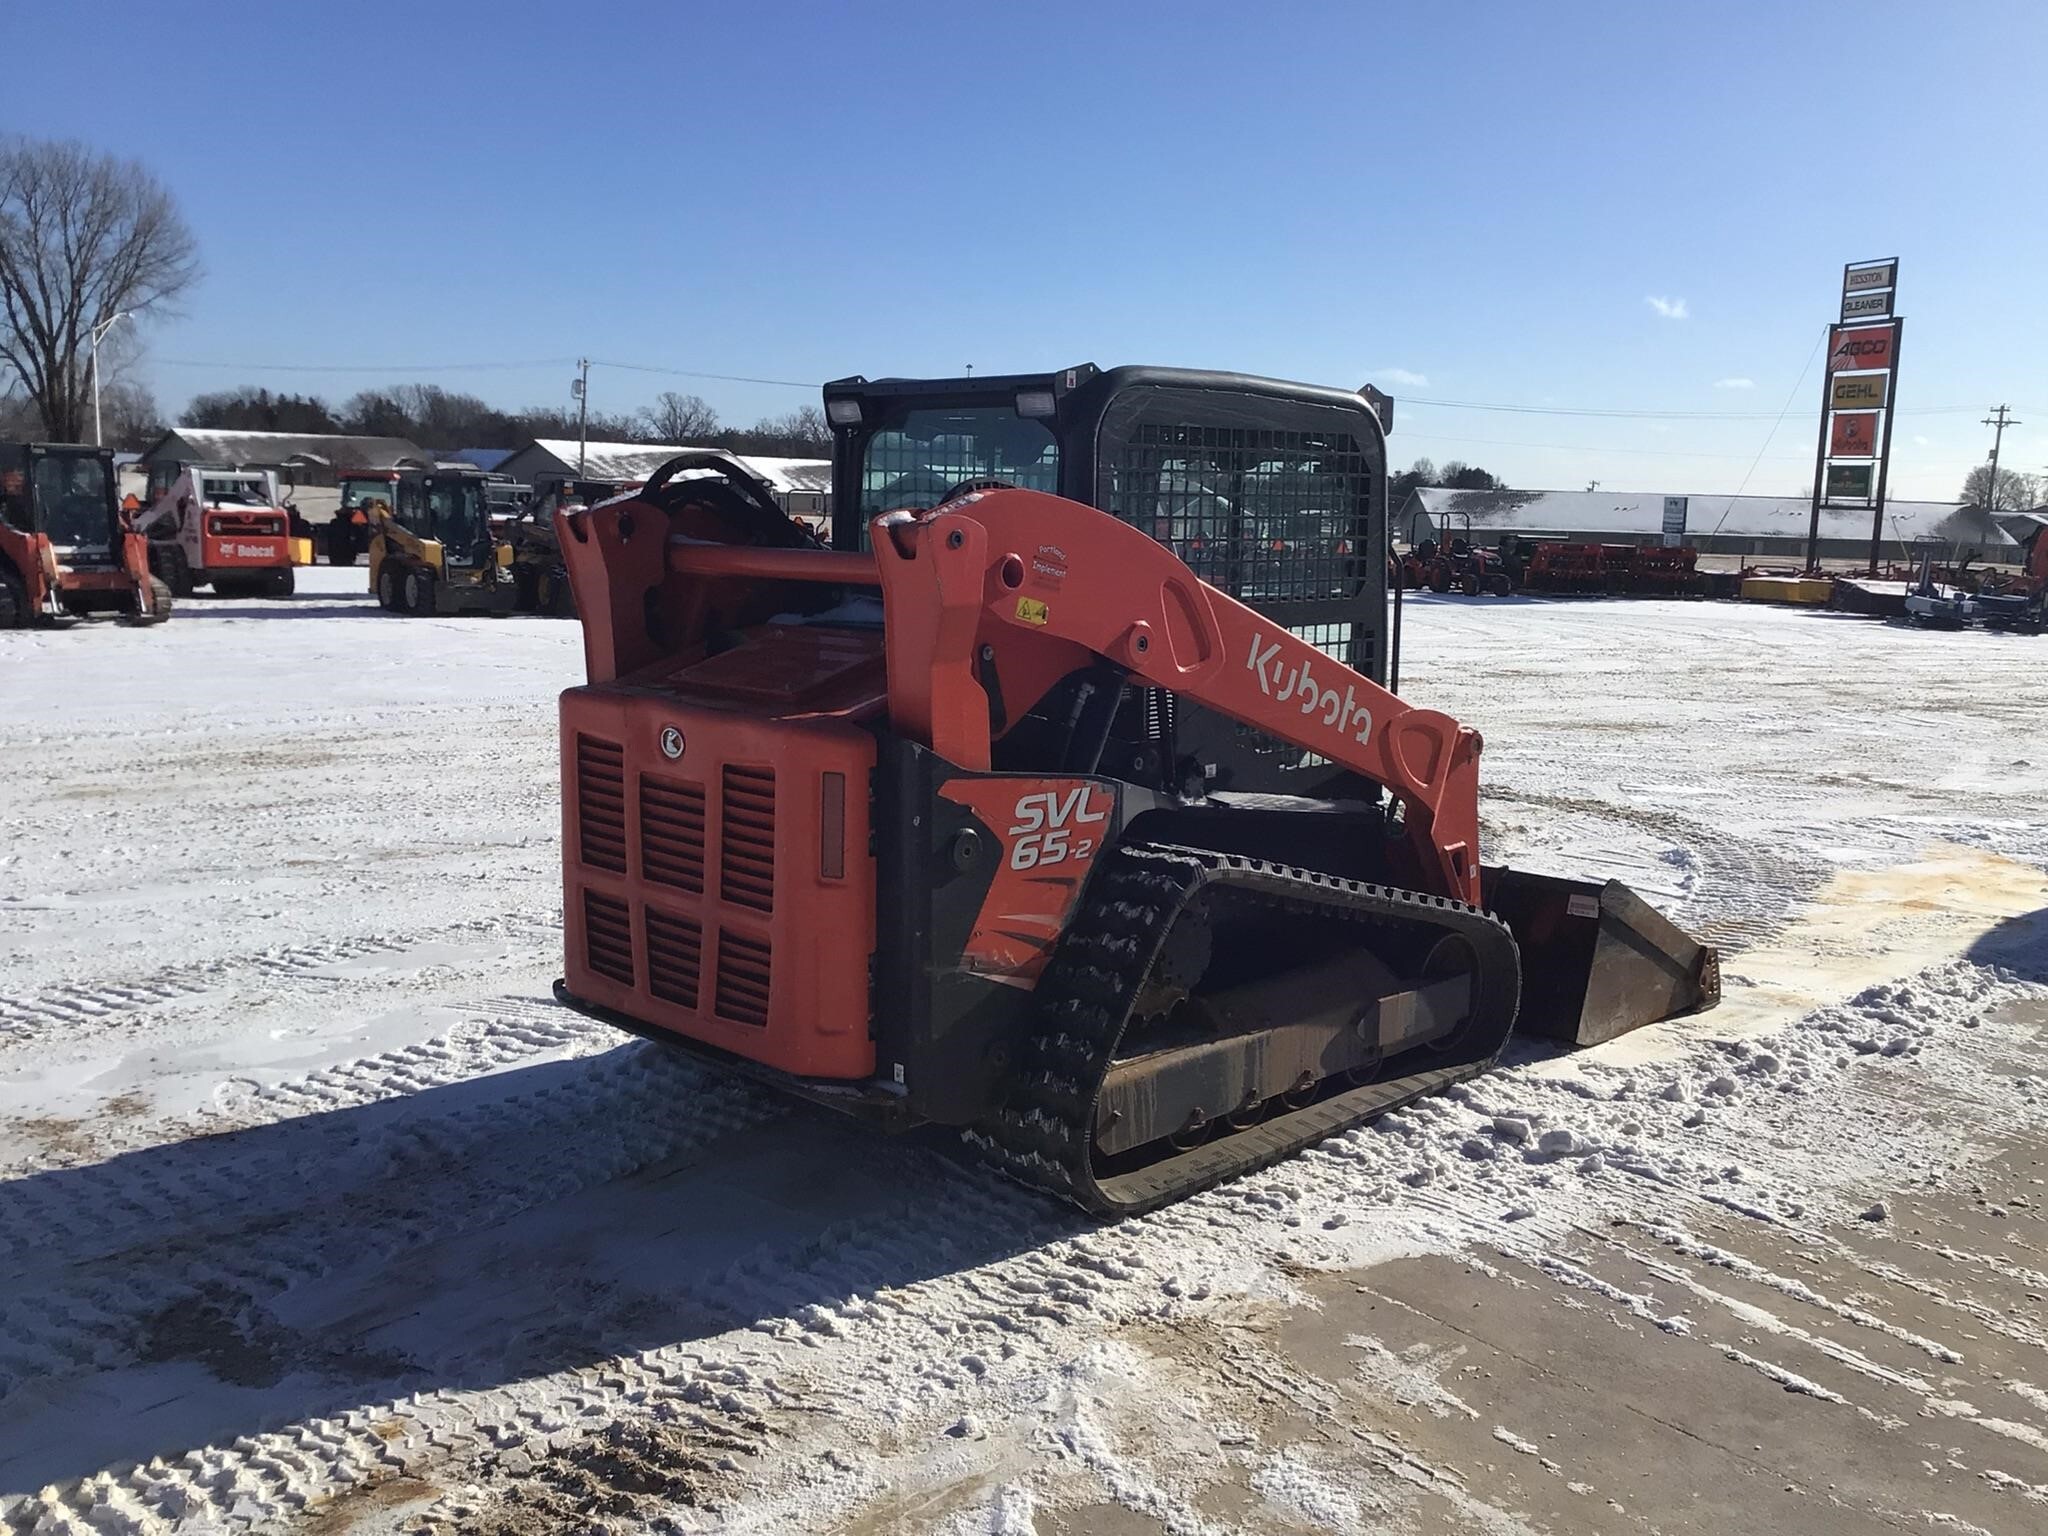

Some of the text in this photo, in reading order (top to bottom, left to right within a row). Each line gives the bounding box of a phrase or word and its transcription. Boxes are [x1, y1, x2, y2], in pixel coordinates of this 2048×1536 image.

[1845, 298, 1884, 313] GLEANER
[1833, 339, 1889, 357] AGCO
[1835, 383, 1879, 399] GEHL
[237, 544, 275, 558] Bobcat
[1038, 544, 1067, 562] Portland
[1032, 559, 1067, 578] Implement
[1247, 632, 1372, 746] Kubota
[1008, 786, 1104, 836] SVL
[1010, 829, 1092, 871] 65-2
